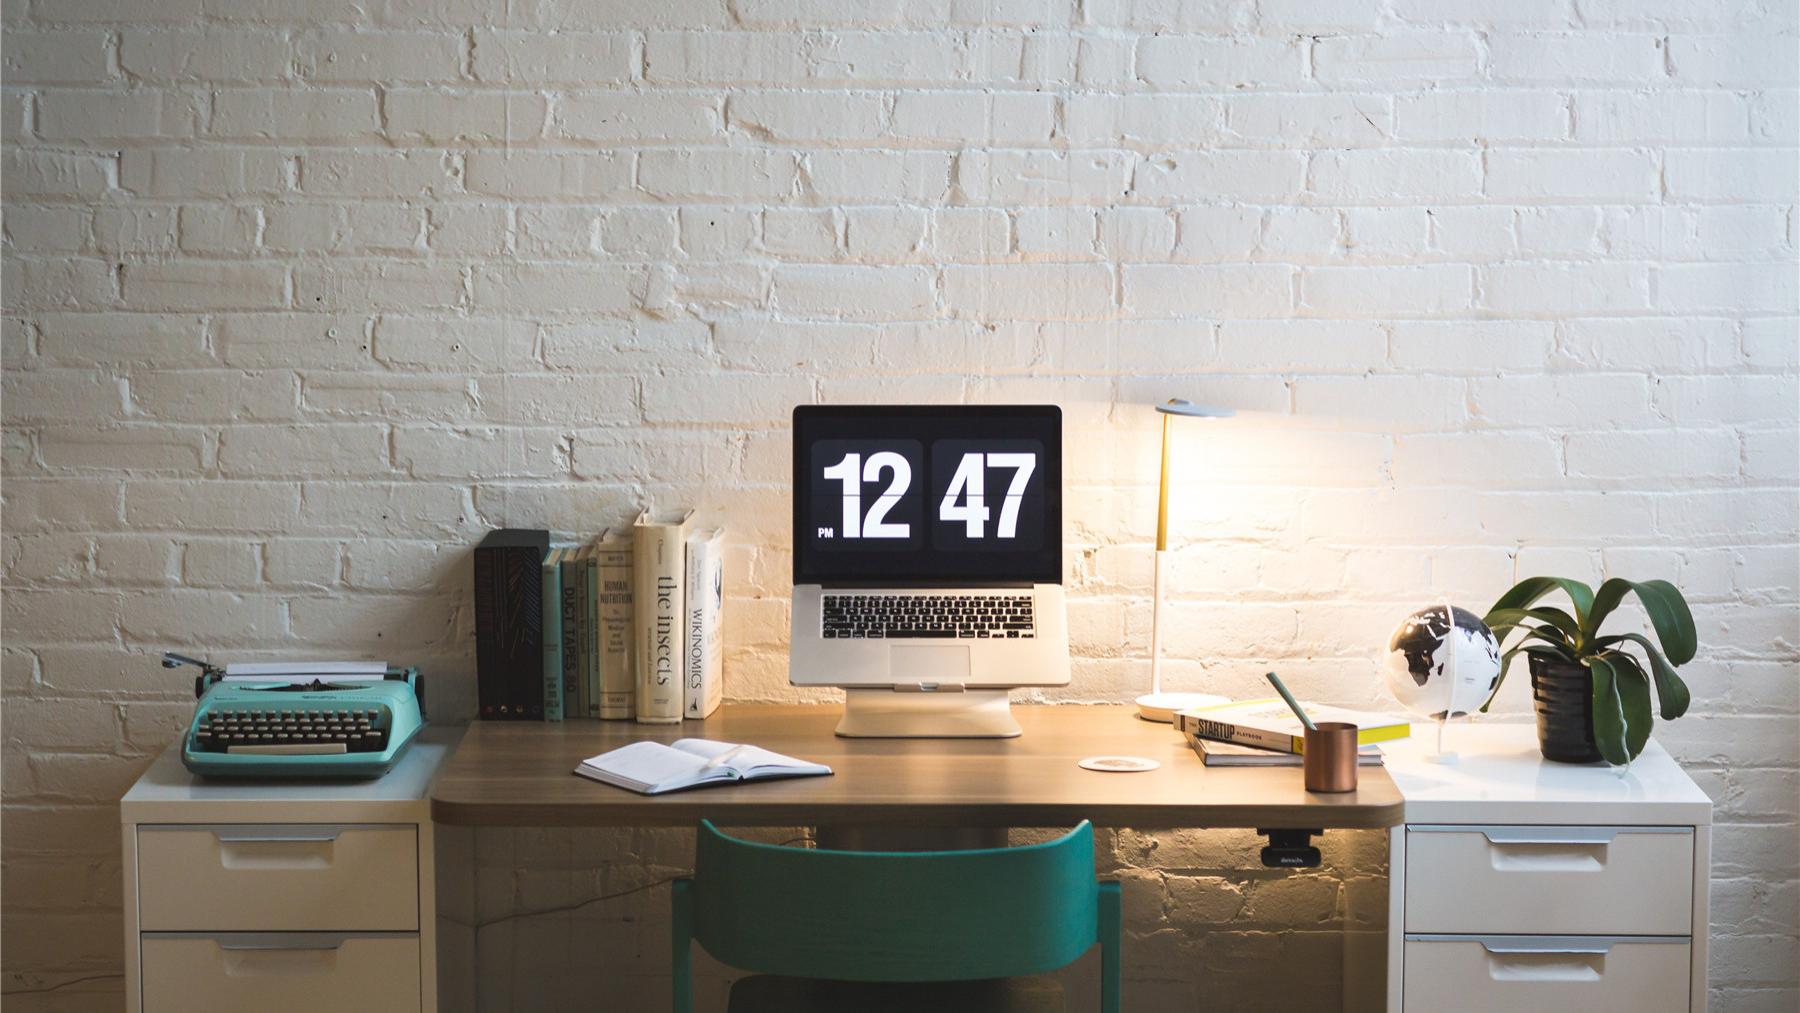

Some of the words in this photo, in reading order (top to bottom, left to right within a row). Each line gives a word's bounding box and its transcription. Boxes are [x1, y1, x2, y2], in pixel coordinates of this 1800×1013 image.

[823, 451, 912, 539] 12
[939, 452, 1036, 539] 47
[817, 527, 834, 539] PM
[600, 592, 633, 605] NUTRITION
[604, 580, 628, 592] HUMAN
[657, 576, 677, 610] the
[564, 586, 576, 623] DUCT
[565, 629, 577, 671] TAPES
[656, 615, 674, 686] insects
[691, 608, 703, 690] WIKINOMICS
[1198, 718, 1235, 740] STARTUP
[1236, 731, 1262, 740] PLAYBOOK
